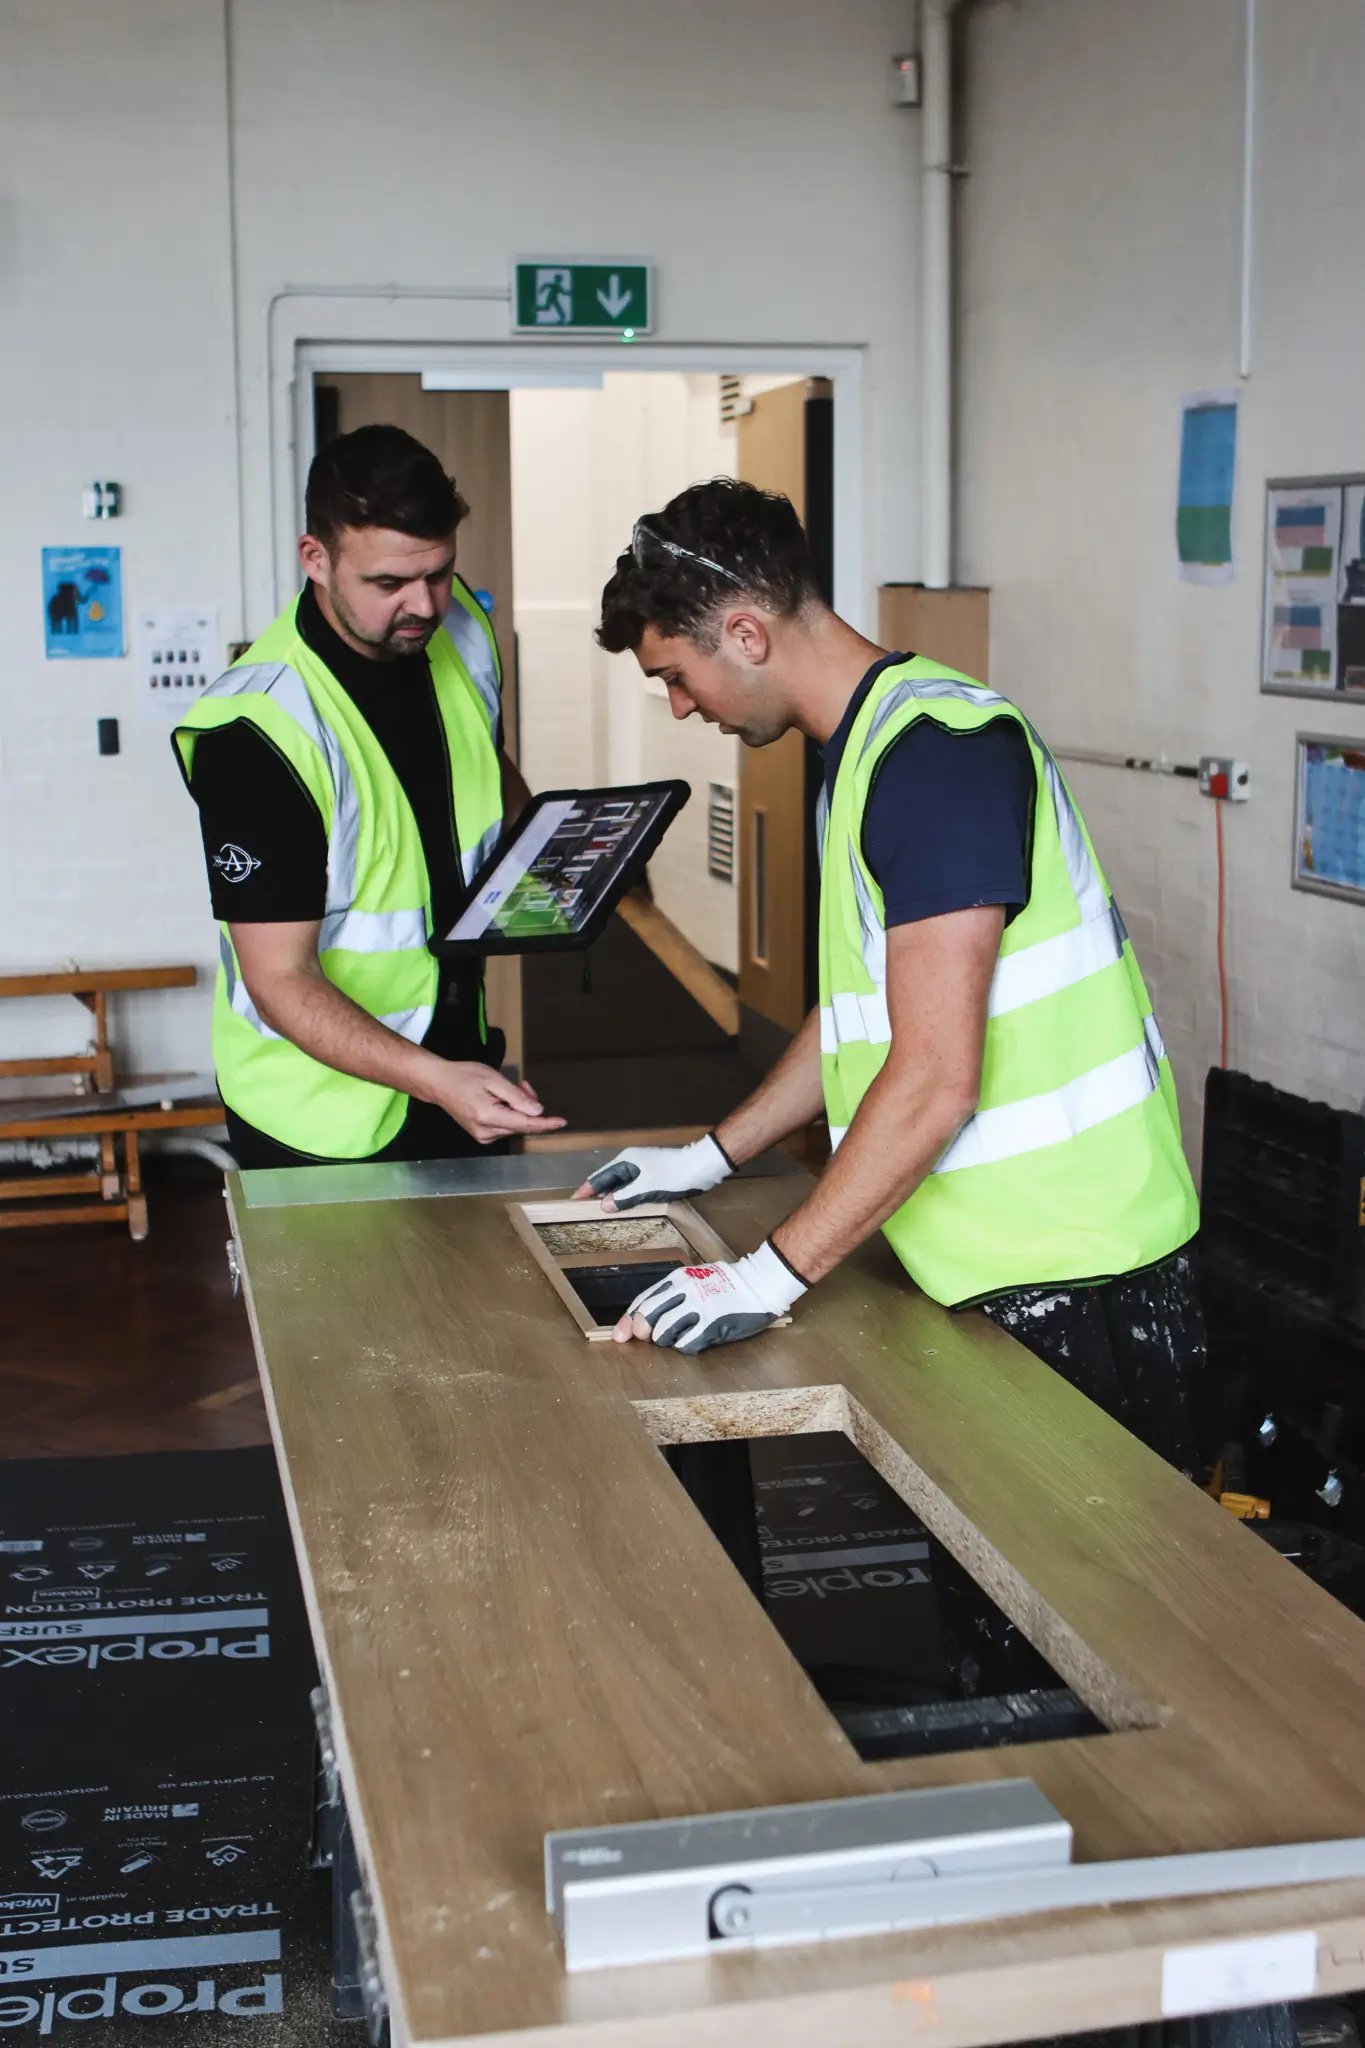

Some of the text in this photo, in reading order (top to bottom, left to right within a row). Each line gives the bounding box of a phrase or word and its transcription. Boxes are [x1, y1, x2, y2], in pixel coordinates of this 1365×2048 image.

[764, 1567, 931, 1598] rople
[5, 1592, 268, 1614] TRADE PROTECTION
[0, 1634, 270, 1669] Proplex
[104, 1805, 172, 1814] BRITAIN
[104, 1812, 168, 1822] MADE IN
[0, 1902, 280, 1936] TRADE PROTECT
